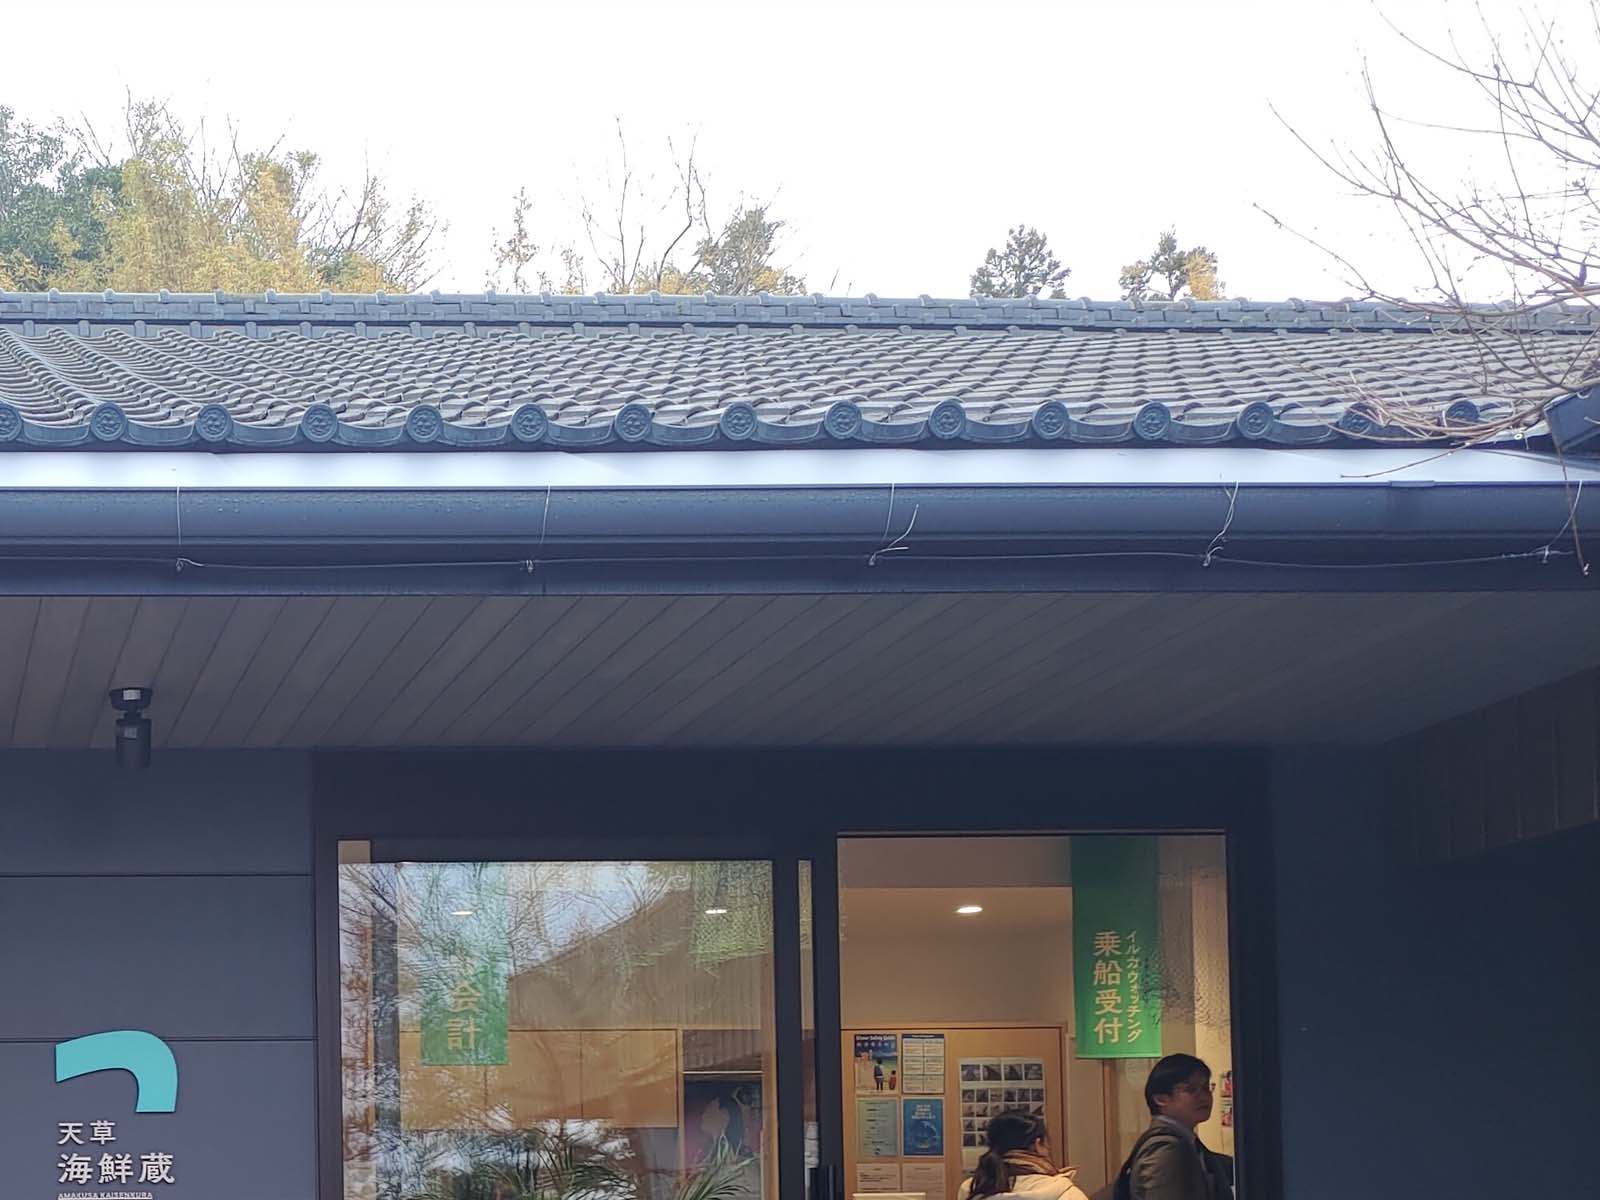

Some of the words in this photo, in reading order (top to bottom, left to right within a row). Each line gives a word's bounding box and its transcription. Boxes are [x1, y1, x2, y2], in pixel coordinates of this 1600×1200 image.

[1093, 930, 1123, 1044] 乗船受付
[1126, 930, 1142, 1043] イルカウォッチング
[448, 981, 481, 1050] 会計
[57, 1120, 117, 1145] 天草
[57, 1152, 176, 1184] 海鮮蔵
[58, 1192, 97, 1200] AMAKUSA
[99, 1192, 152, 1200] KAISENKURA
